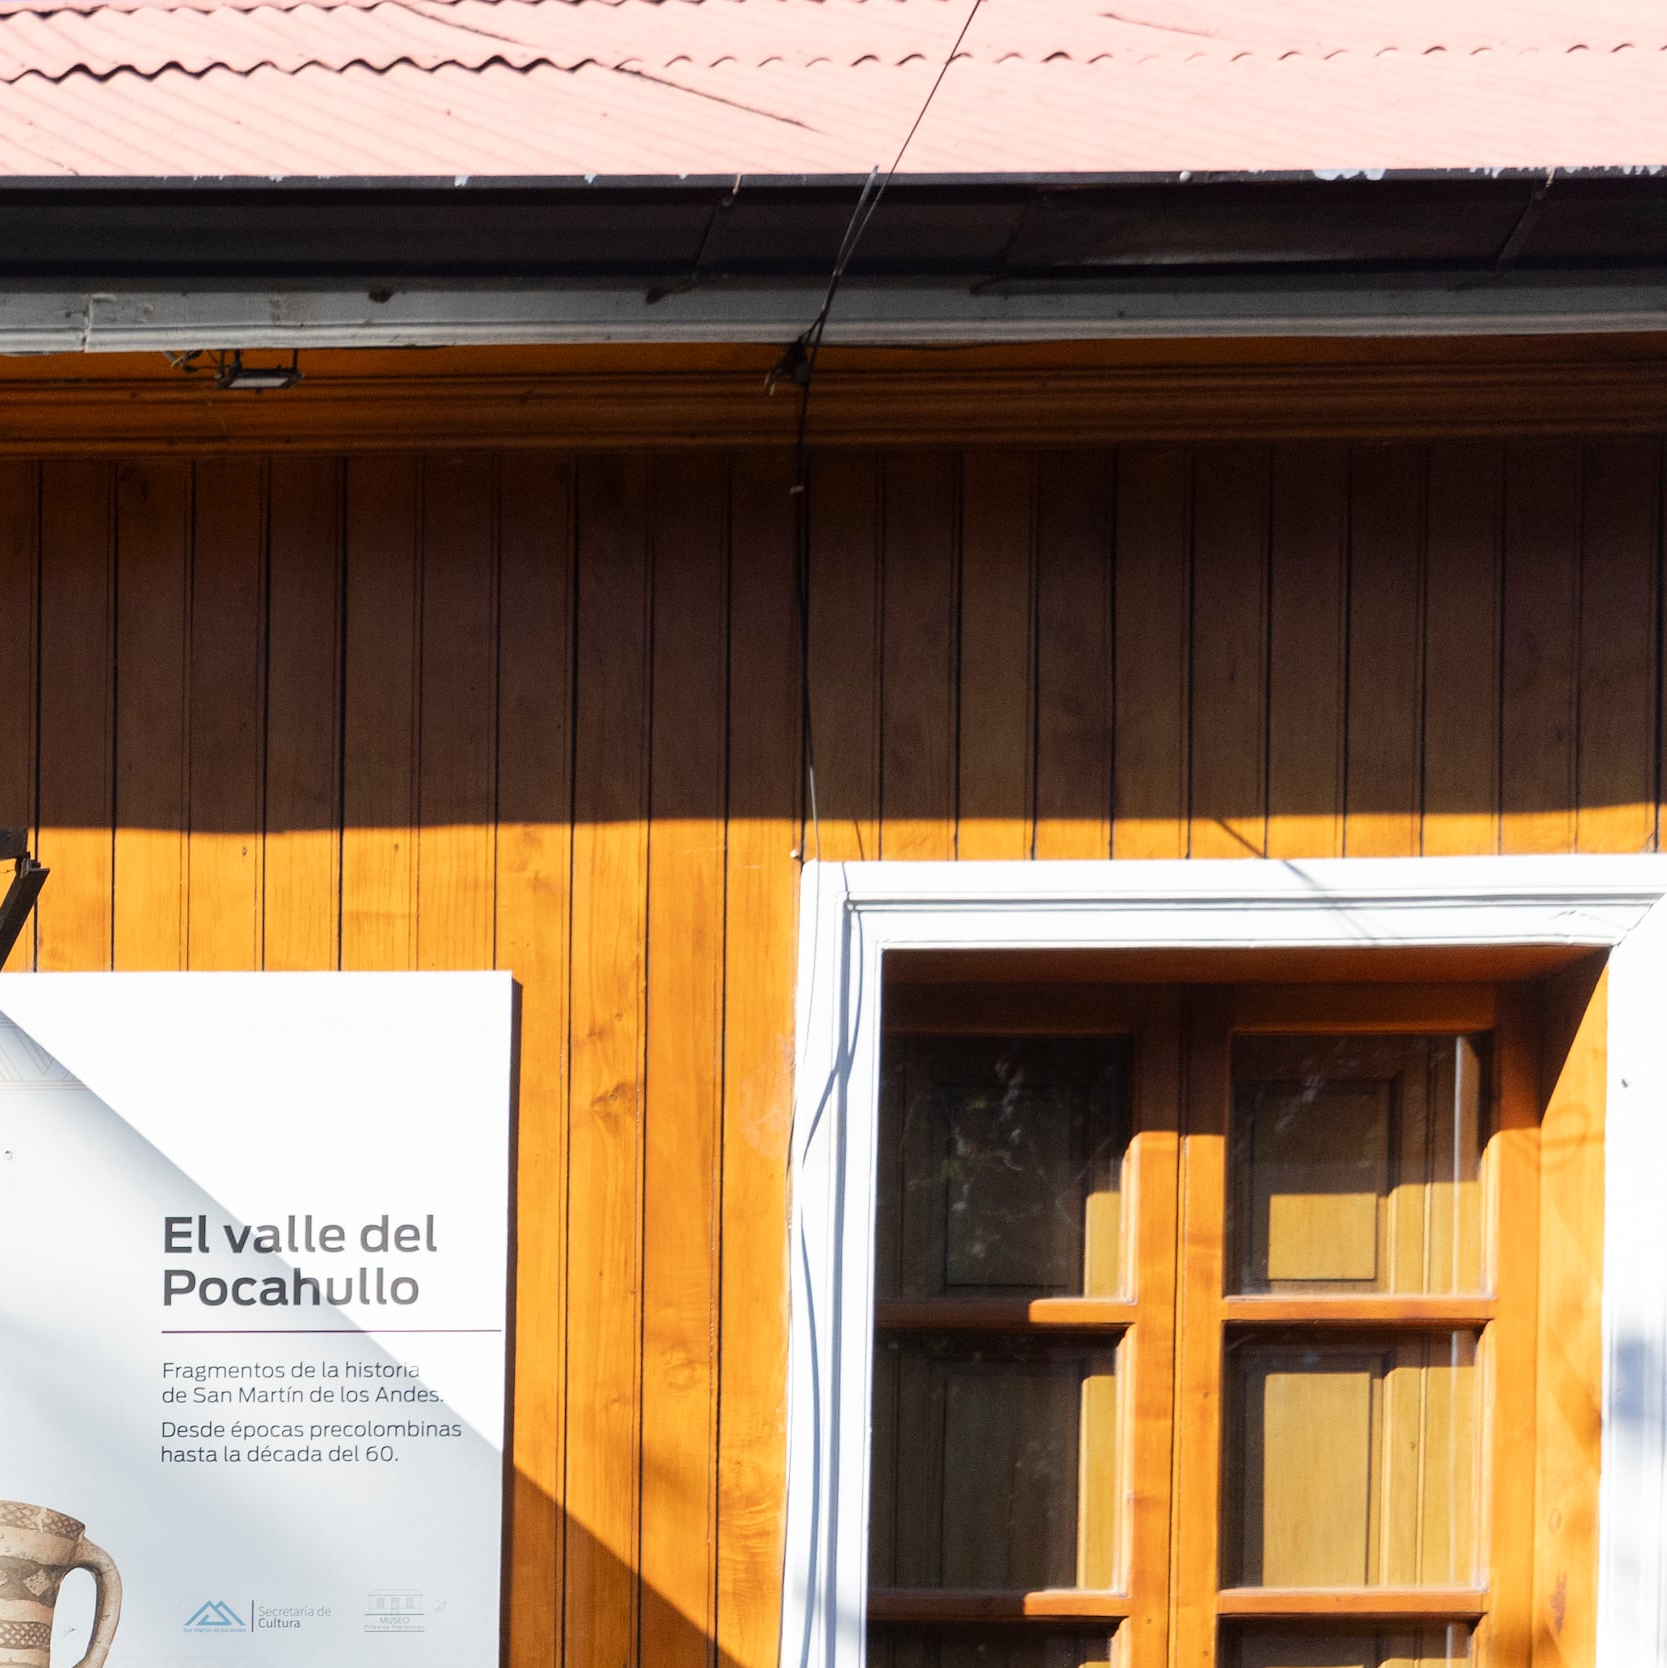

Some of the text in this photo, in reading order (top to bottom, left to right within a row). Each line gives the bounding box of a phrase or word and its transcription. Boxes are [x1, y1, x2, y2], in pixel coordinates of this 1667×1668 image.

[164, 1214, 437, 1254] El valle del
[163, 1267, 419, 1306] Pocahullo
[163, 1362, 419, 1382] Fragmentos de la historia
[162, 1386, 444, 1403] de San Martín de los Andes.
[161, 1420, 461, 1441] Desde épocas precolombinas
[161, 1445, 398, 1462] hasta la década del 60.
[317, 1606, 331, 1616] de
[258, 1618, 300, 1629] Cultura
